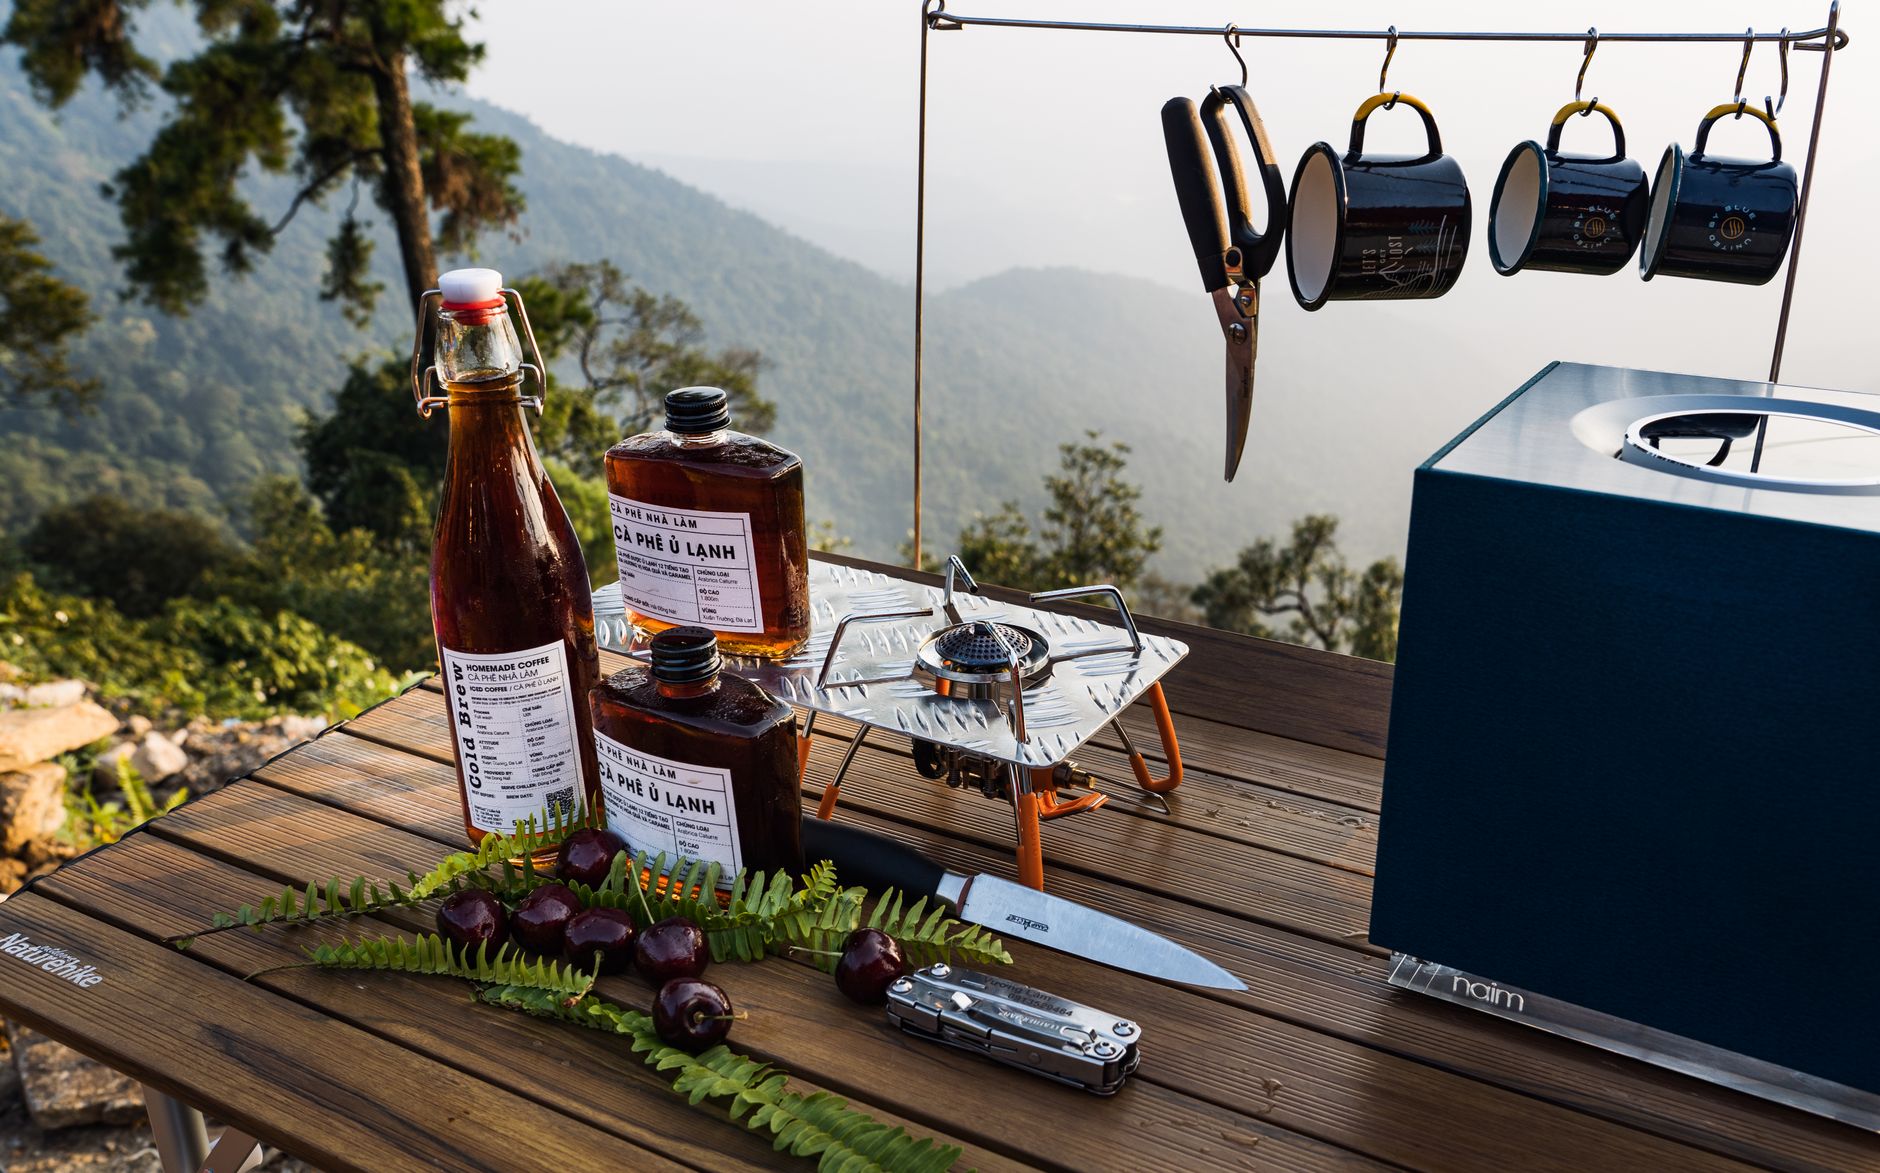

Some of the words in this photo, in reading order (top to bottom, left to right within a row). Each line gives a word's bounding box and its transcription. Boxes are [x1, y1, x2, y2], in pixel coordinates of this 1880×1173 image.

[1588, 205, 1616, 220] BLUE
[1724, 204, 1756, 220] BLUE
[1388, 236, 1403, 260] LOST
[1709, 234, 1752, 250] UNITED
[610, 502, 622, 514] CÀ
[625, 507, 642, 519] PHÊ
[646, 512, 668, 525] NHÀ
[673, 516, 697, 528] LÀM
[614, 524, 632, 543] CÀ
[636, 533, 664, 551] PHÊ
[669, 535, 680, 554] Ủ
[686, 542, 735, 561] LẠNH
[668, 571, 692, 580] CARAMEL
[466, 663, 516, 672] HOMEMADE
[518, 656, 550, 670] COFFEE
[468, 671, 480, 681] CÀ
[481, 673, 497, 682] PHÊ
[498, 671, 518, 680] NHÀ
[519, 669, 538, 679] LÀM
[452, 661, 471, 728] Brew
[513, 683, 524, 691] CÀ
[462, 737, 482, 789] Cold
[607, 745, 622, 761] PHÊ
[626, 756, 648, 771] NHÀ
[653, 765, 676, 779] LÀM
[598, 761, 614, 783] CÀ
[617, 773, 643, 797] PHÊ
[649, 782, 659, 802] Ủ
[666, 791, 715, 815] LẠNH
[0, 932, 103, 988] Naturehike
[1453, 976, 1524, 1012] naim
